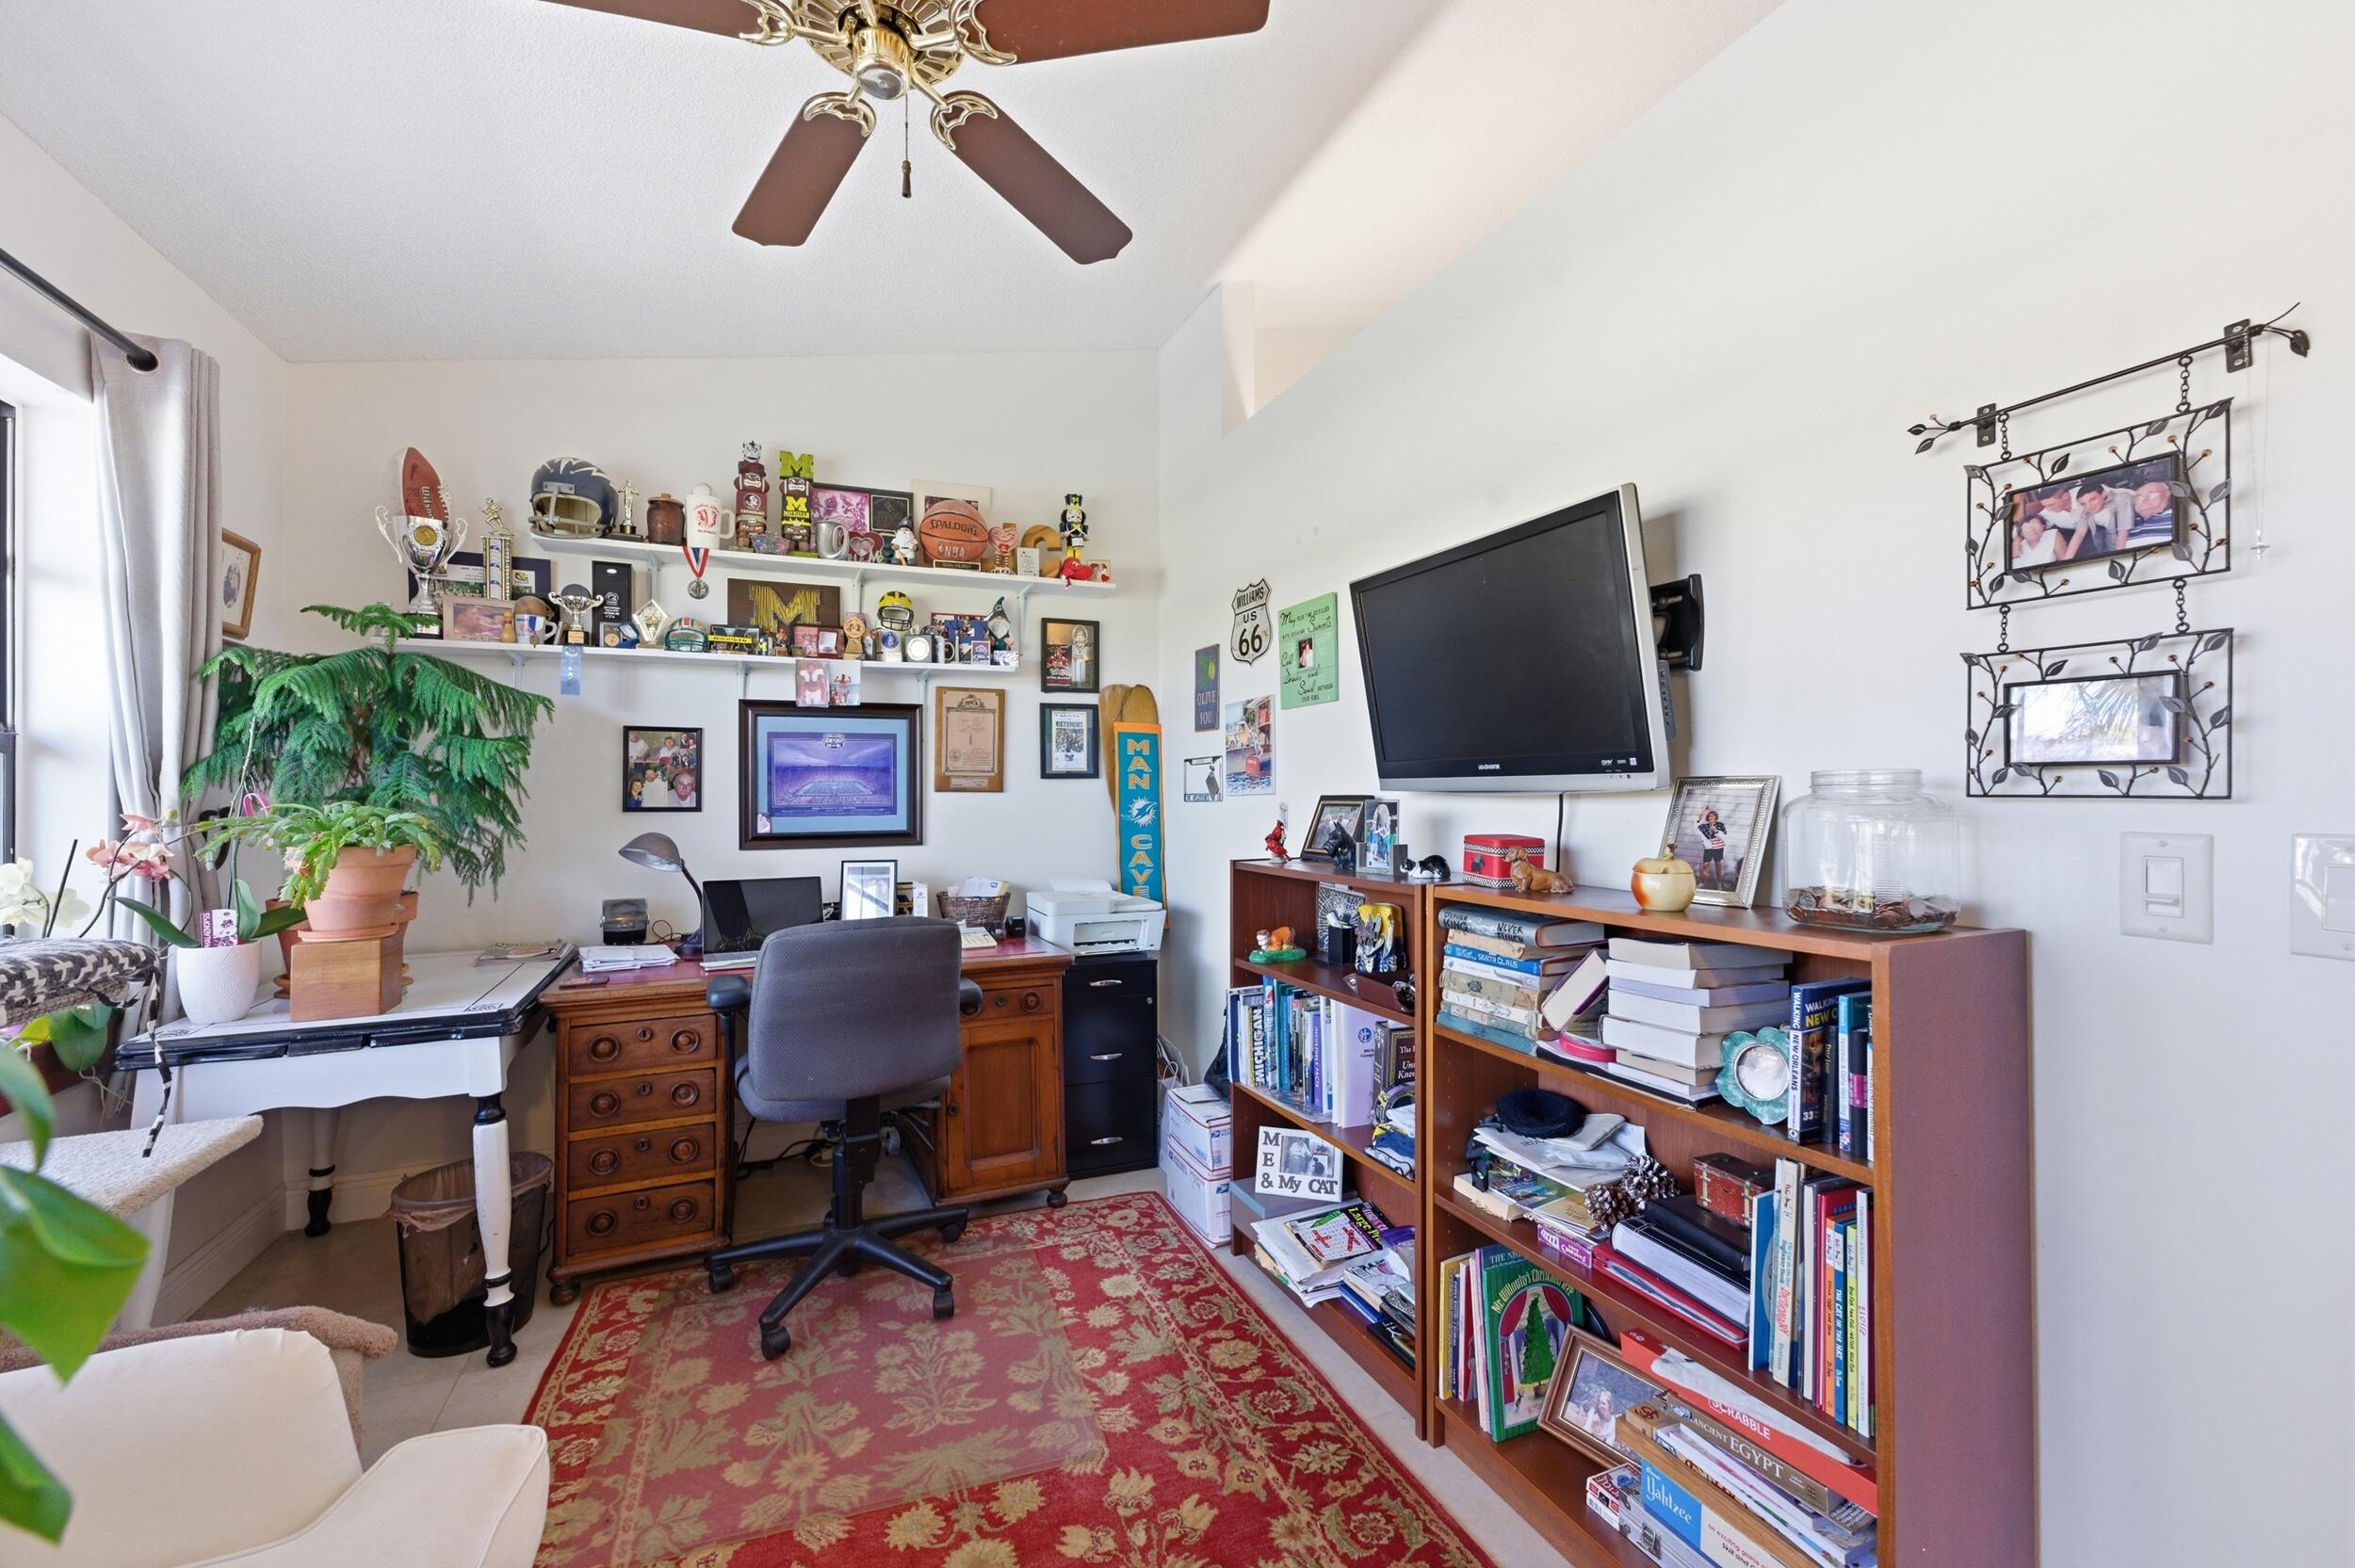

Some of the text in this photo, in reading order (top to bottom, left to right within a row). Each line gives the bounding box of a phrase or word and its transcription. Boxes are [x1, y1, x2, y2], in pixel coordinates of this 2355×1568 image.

[786, 495, 807, 511] M
[929, 519, 979, 536] SPALDING
[1236, 589, 1264, 609] WILLIAMS
[1242, 610, 1258, 623] US
[1238, 623, 1263, 657] 66
[1196, 689, 1216, 705] OLIVE
[1127, 738, 1154, 898] MAN CAVE
[1443, 918, 1469, 932] KING
[1497, 923, 1523, 934] NEVER
[1497, 958, 1519, 968] CLAUS
[1792, 992, 1802, 1029] WALKING
[1805, 1010, 1829, 1027] NEW
[1252, 1008, 1266, 1083] MICHIGAN
[1399, 1045, 1411, 1054] The
[1791, 1033, 1800, 1054] NEW
[1791, 1055, 1799, 1091] ORLEANS
[1260, 1173, 1338, 1195] & My CAT
[1489, 1253, 1506, 1264] THE
[1835, 1289, 1843, 1302] THE
[1835, 1303, 1843, 1318] CAT
[1835, 1319, 1843, 1328] IN
[1835, 1330, 1843, 1342] THE
[1835, 1343, 1843, 1360] HAT
[1709, 1397, 1771, 1442] SCRABBLE
[1692, 1417, 1784, 1479] ANCIENT EGYPT
[1646, 1475, 1693, 1525] Yahtzee
